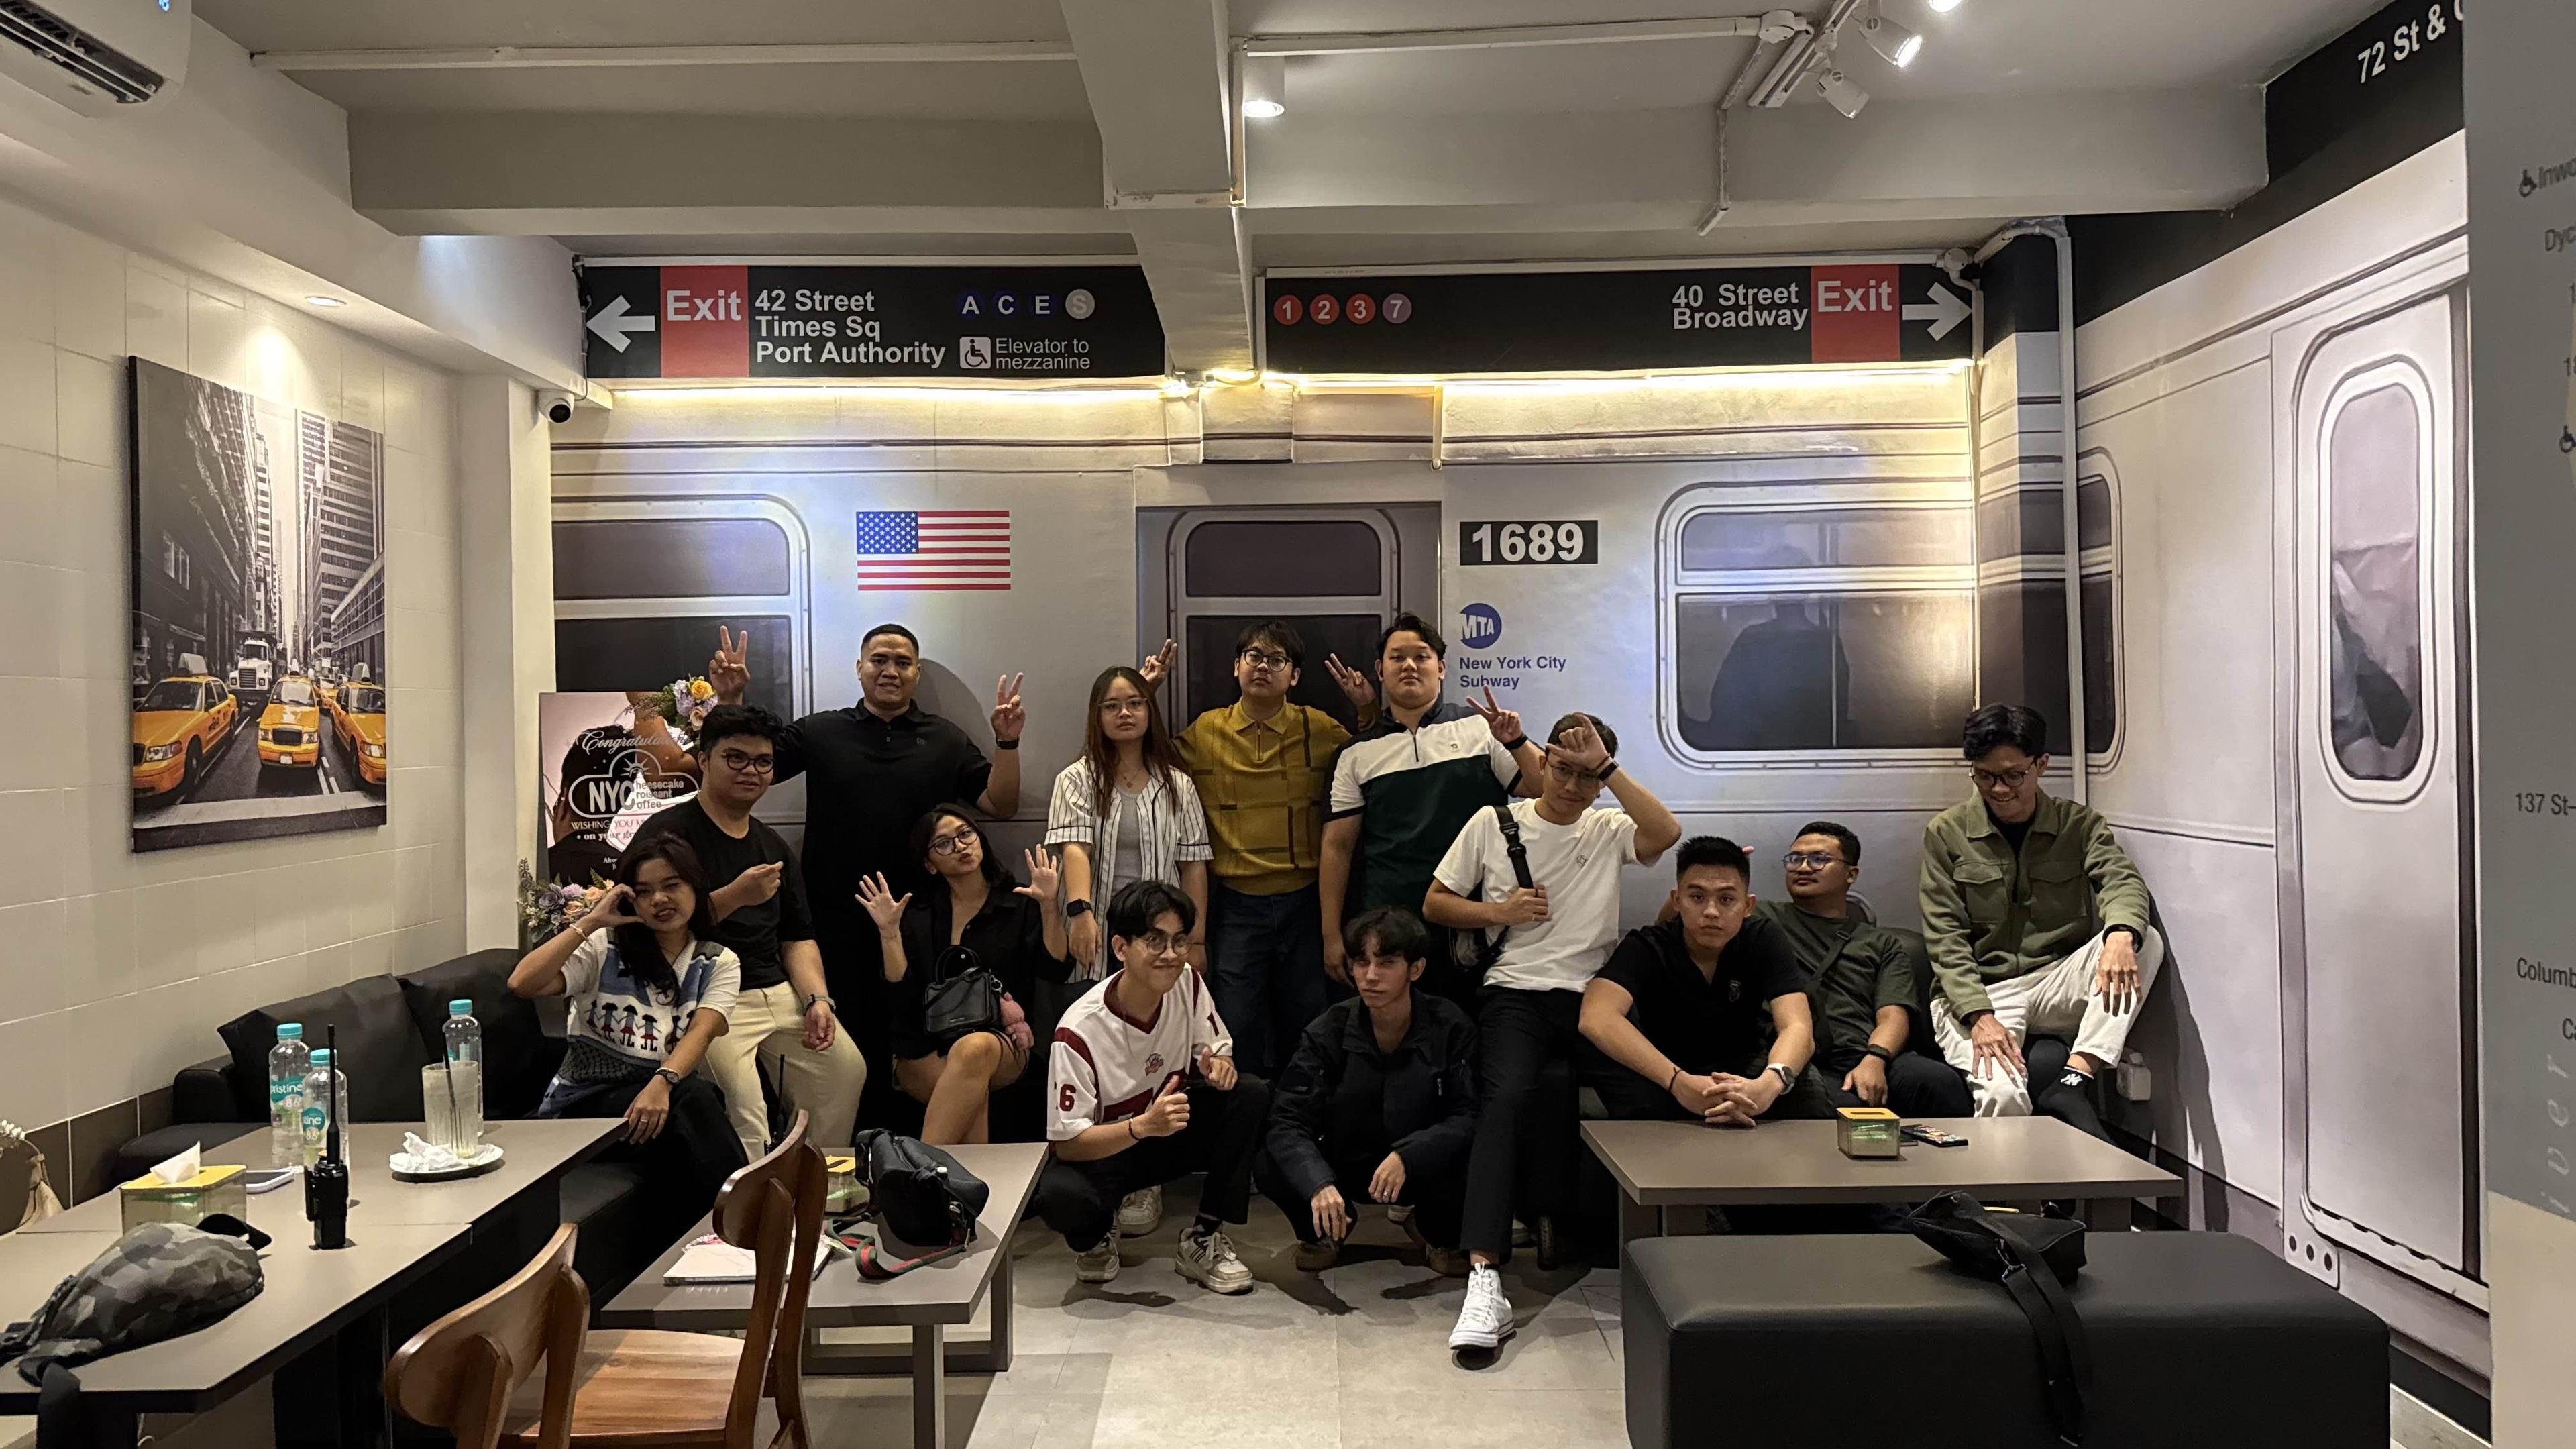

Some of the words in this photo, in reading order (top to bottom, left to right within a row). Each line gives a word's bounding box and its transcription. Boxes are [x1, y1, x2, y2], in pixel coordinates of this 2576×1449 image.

[2357, 40, 2386, 83] 72
[2393, 19, 2420, 61] St
[2426, 3, 2446, 41] &
[755, 290, 786, 311] 42
[794, 289, 875, 312] Street
[961, 295, 980, 315] A
[998, 295, 1014, 315] C
[1035, 295, 1051, 315] E
[1073, 294, 1088, 315] S
[1672, 285, 1703, 307] 40
[1718, 276, 1799, 306] Street
[1817, 279, 1893, 313] Exit
[667, 290, 741, 322] Exit
[1282, 301, 1292, 320] 1
[1318, 300, 1331, 319] 2
[1354, 300, 1367, 319] 3
[1390, 299, 1403, 319] 7
[1673, 305, 1809, 331] Broadway
[755, 315, 837, 337] Times
[845, 315, 881, 342] Sq
[756, 341, 812, 364] Port
[820, 341, 945, 368] Authority
[996, 337, 1068, 354] Elevator
[1073, 338, 1089, 354] to
[996, 354, 1091, 369] mezzanine
[1472, 523, 1584, 562] 1689
[1460, 613, 1495, 639] MTA
[1460, 657, 1492, 669] New
[1497, 657, 1532, 669] York
[1536, 656, 1566, 672] City
[1460, 674, 1519, 690] Subway
[588, 781, 635, 813] NYC
[637, 800, 662, 810] offee
[2516, 793, 2545, 813] 137
[571, 820, 611, 830] WISHING
[614, 819, 633, 828] YOU
[2517, 957, 2576, 989] Columb
